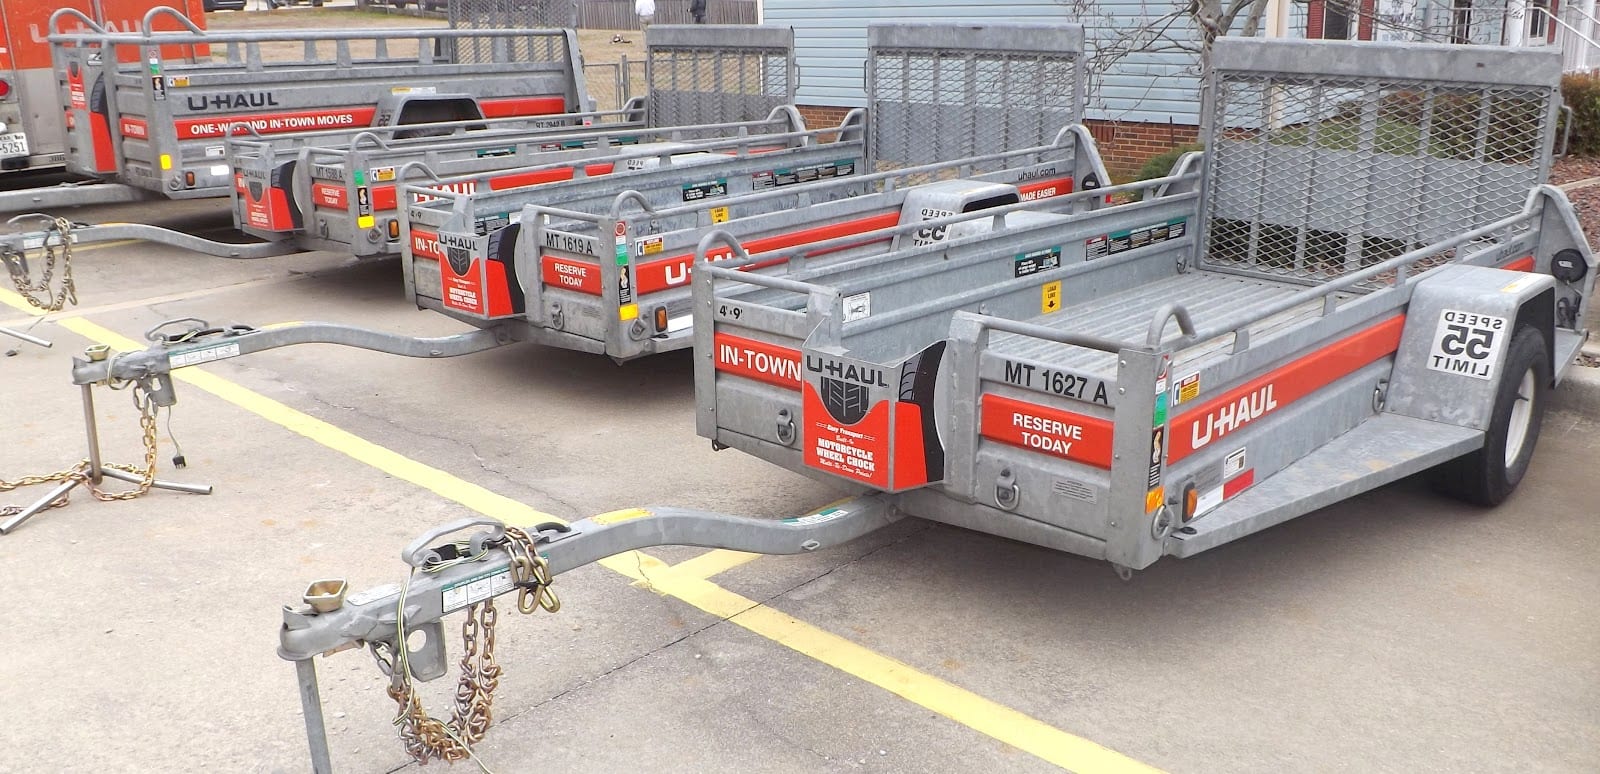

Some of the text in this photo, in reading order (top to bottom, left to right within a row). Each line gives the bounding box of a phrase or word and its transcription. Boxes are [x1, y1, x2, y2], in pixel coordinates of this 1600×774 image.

[29, 20, 153, 43] U-HAU
[187, 92, 279, 111] U-HAUL
[190, 122, 242, 135] ONE-W
[270, 116, 315, 128] IN-TOWN
[317, 114, 353, 125] MOVES
[1017, 167, 1056, 181] uhaul.com
[1020, 187, 1057, 202] MADE EASIER
[415, 236, 440, 255] IN-TO
[438, 233, 478, 251] U-HAUL
[546, 233, 593, 254] MT 1619 A
[554, 263, 587, 278] RESERVE
[559, 274, 583, 288] TODAY
[719, 344, 801, 382] IN-TOWN
[806, 354, 889, 387] U-HAUL
[1005, 360, 1109, 405] MT 1627 A
[1012, 412, 1083, 441] RESERVE
[1191, 383, 1277, 450] U-HAUL
[817, 437, 874, 461] MOTORCYCLE
[1021, 431, 1072, 455] TODAY
[816, 447, 876, 472] WHEEL CHOCK
